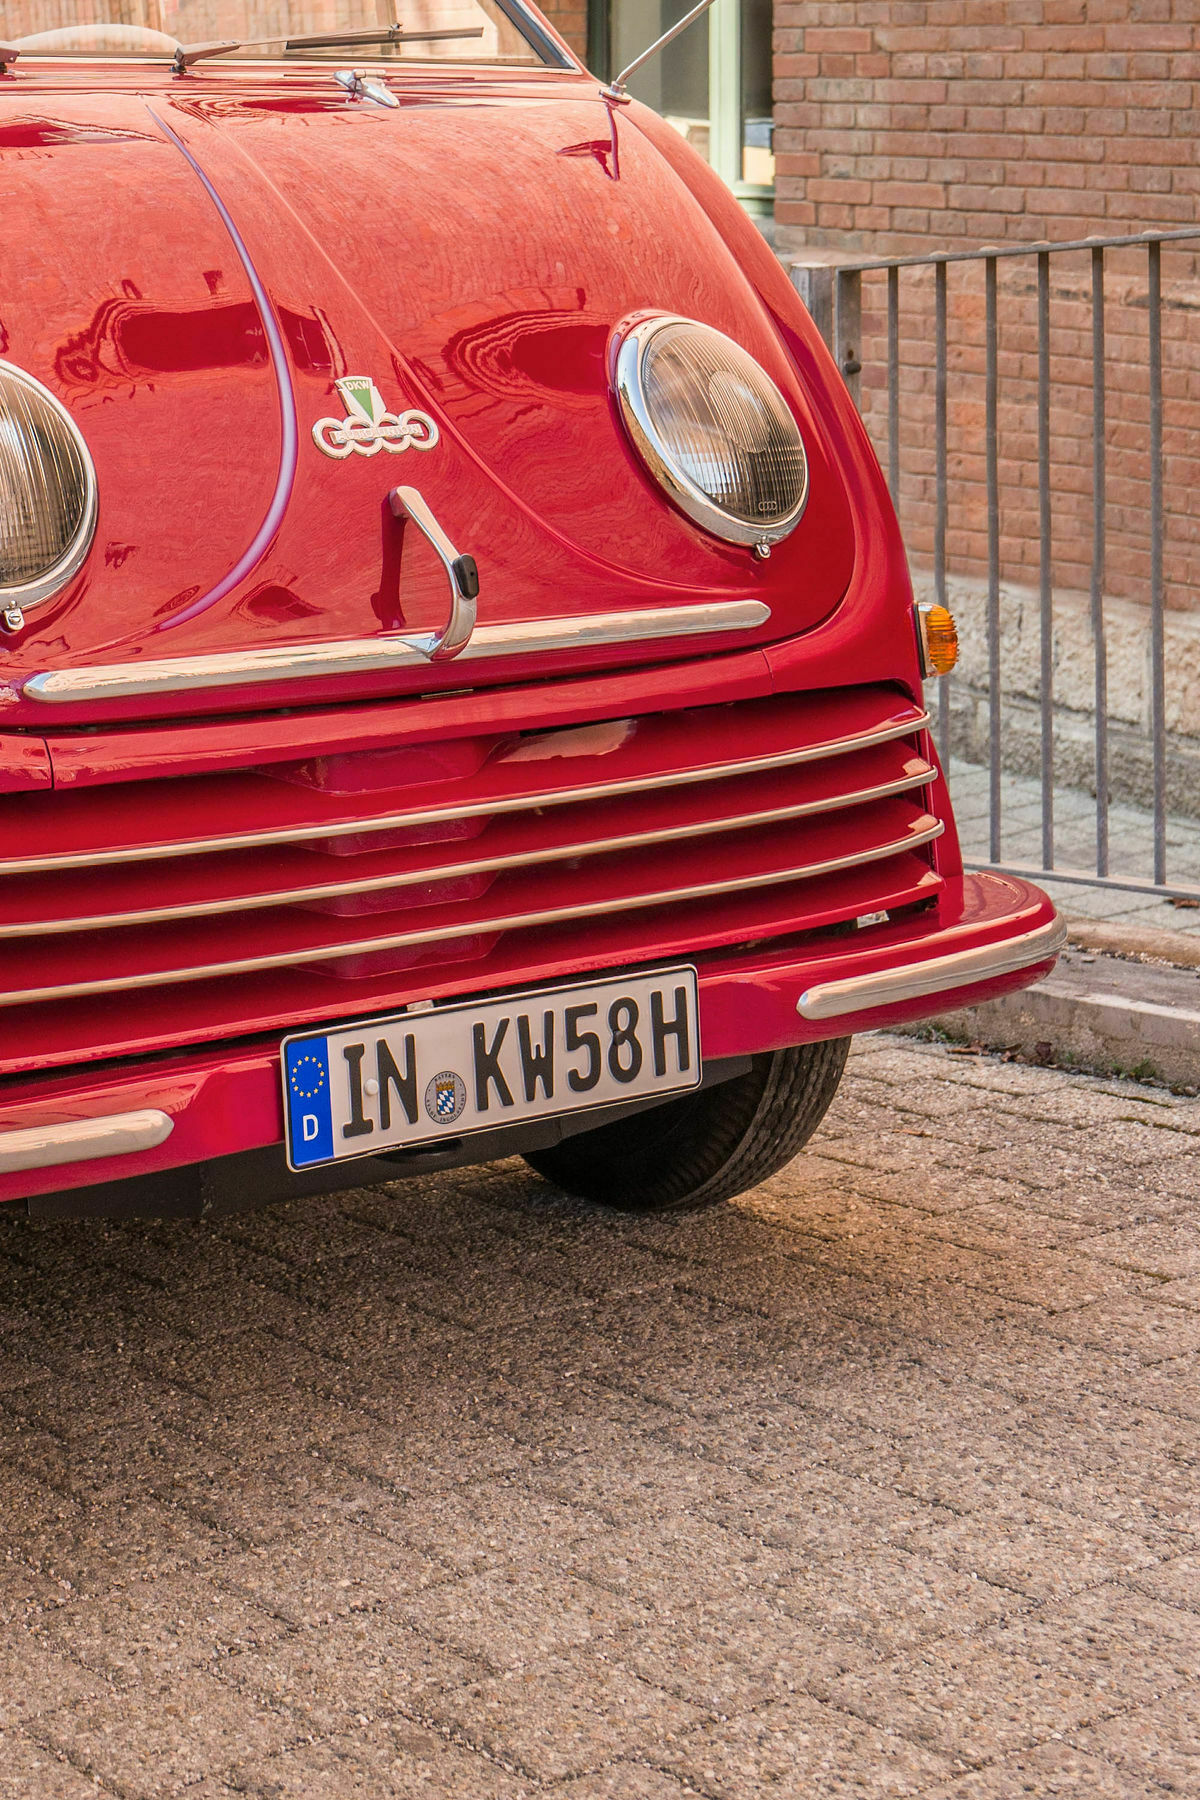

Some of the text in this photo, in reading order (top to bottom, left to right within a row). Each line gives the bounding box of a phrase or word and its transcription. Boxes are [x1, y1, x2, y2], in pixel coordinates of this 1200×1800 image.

[345, 380, 370, 390] DKW
[342, 1033, 419, 1138] IN
[302, 1113, 319, 1142] D
